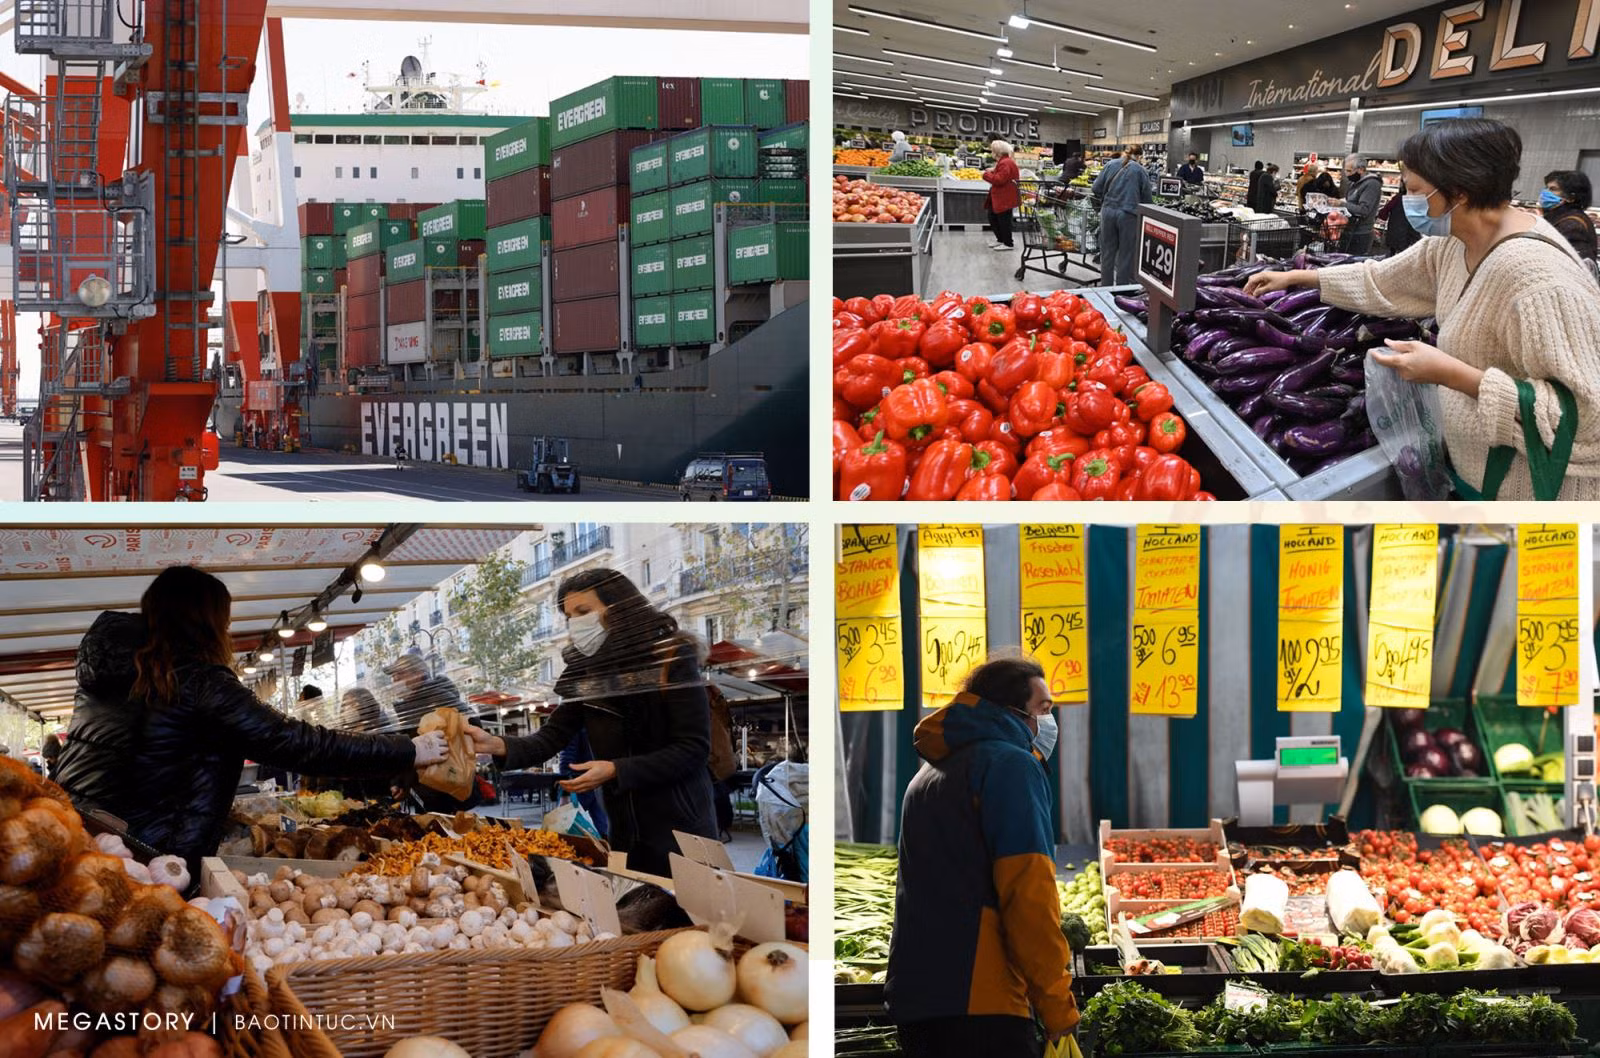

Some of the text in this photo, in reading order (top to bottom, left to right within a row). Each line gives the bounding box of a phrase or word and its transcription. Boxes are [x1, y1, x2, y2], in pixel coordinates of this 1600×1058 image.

[1241, 48, 1384, 110] International
[558, 96, 606, 132] EVERGREEN
[910, 107, 1041, 140] PRODUCE
[1142, 121, 1160, 133] SALADS
[496, 138, 528, 161] EVERGREEN
[675, 145, 705, 162] EVERGREEN
[1163, 183, 1178, 192] 1.29
[422, 214, 454, 236] EVERGREEN
[497, 235, 529, 254] EVERGREEN
[736, 243, 769, 260] EVERGREEN
[677, 254, 706, 268] EVERGREEN
[1144, 239, 1173, 276] 1.29
[498, 282, 530, 300] EVERGREEN
[678, 308, 708, 322] EVERGREEN
[500, 326, 531, 342] EVERGREEN
[360, 402, 509, 469] EVERGREEN
[126, 528, 141, 552] PARIS
[1143, 534, 1198, 548] HOLLAND
[1284, 536, 1336, 549] HOLLAND
[1524, 530, 1576, 546] HOLLAND
[1024, 612, 1045, 641] 500
[1520, 618, 1544, 644] 500
[1134, 624, 1156, 650] 500
[1280, 638, 1302, 669] 100
